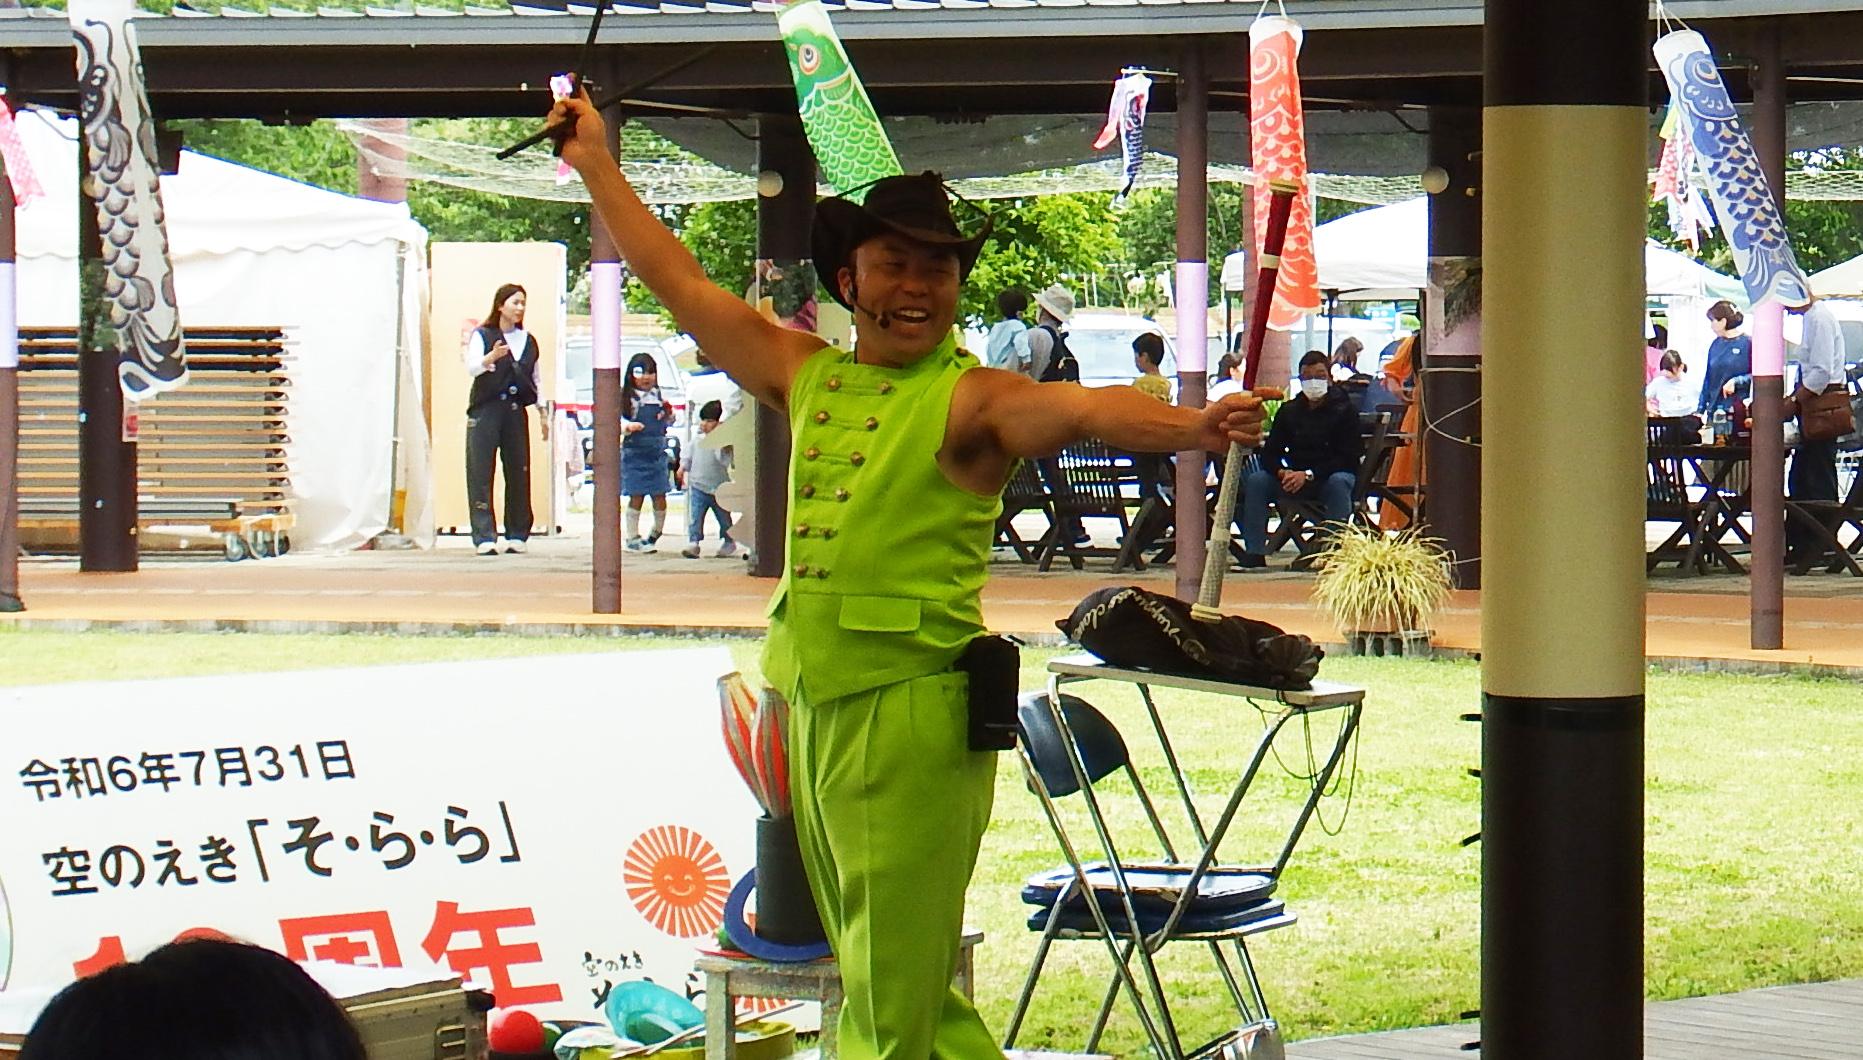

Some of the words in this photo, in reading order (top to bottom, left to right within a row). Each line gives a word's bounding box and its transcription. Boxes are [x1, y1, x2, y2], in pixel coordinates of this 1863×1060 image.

[19, 740, 356, 802] 令和6年7月31日
[582, 950, 644, 977] 空のえき
